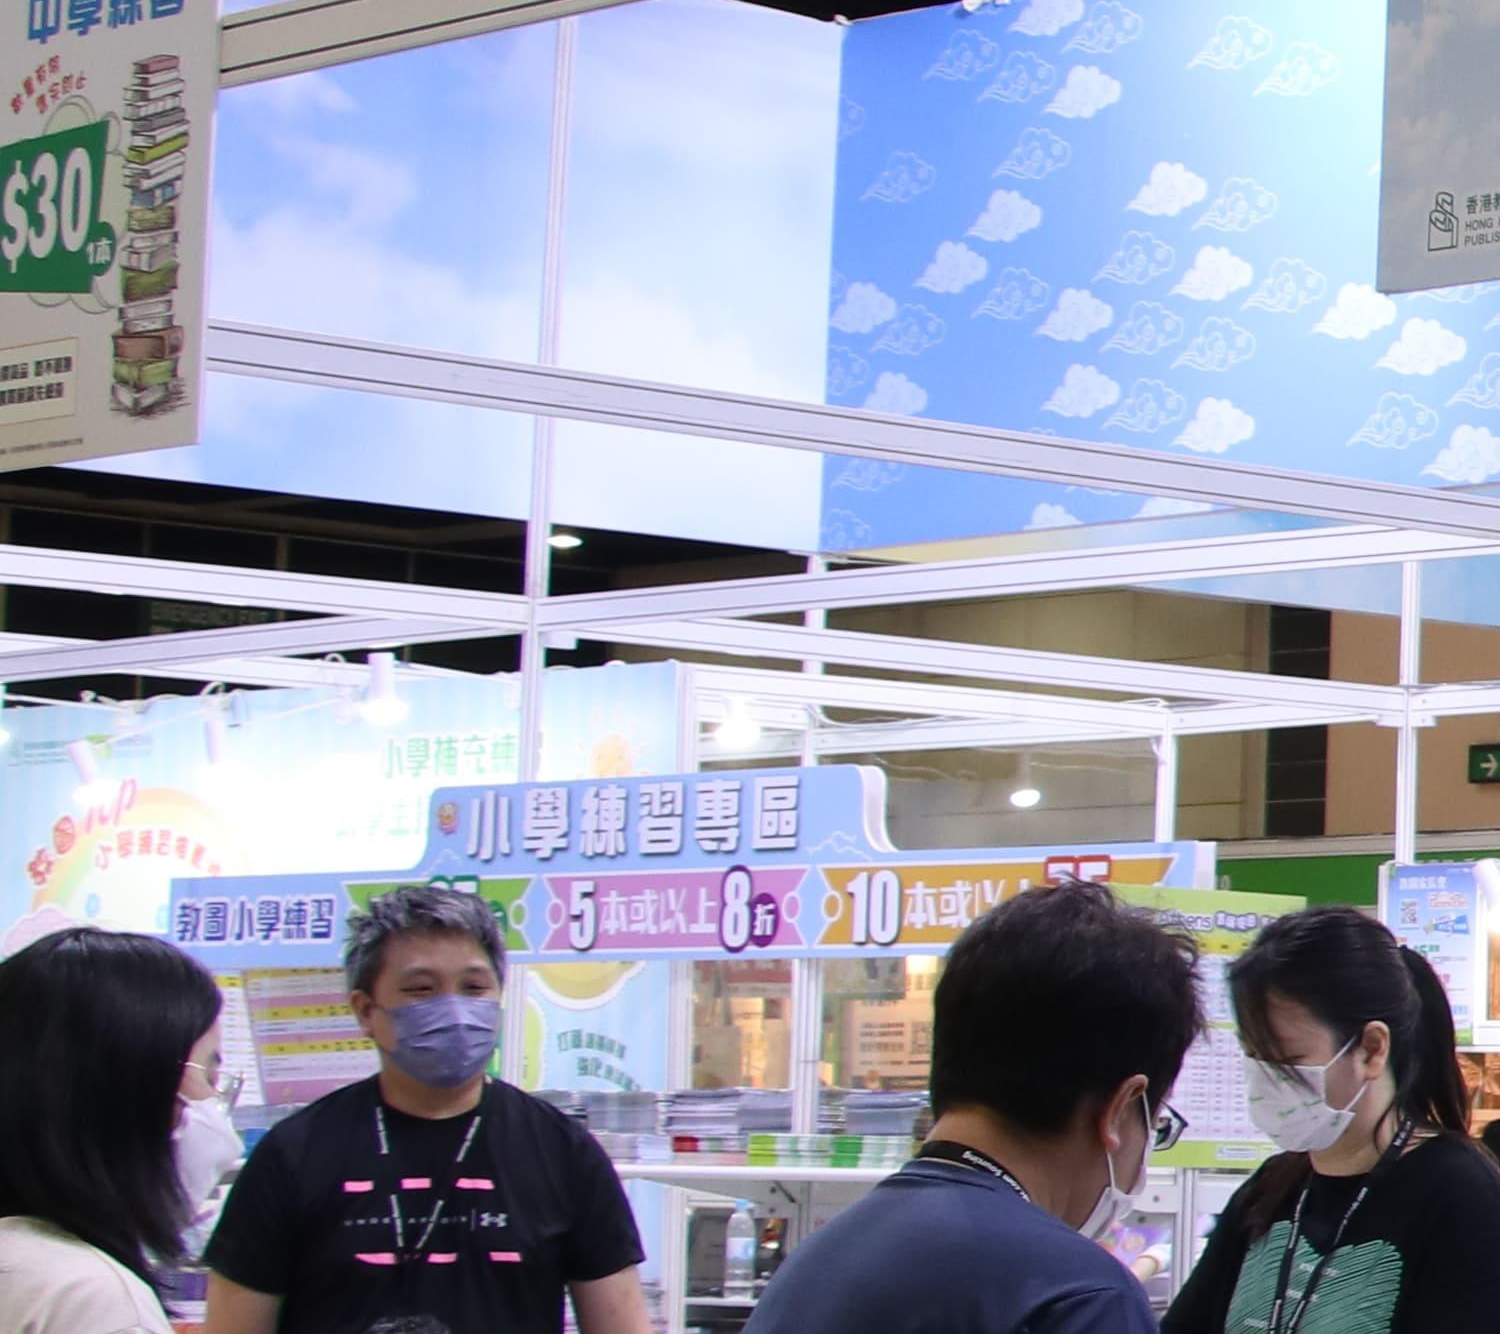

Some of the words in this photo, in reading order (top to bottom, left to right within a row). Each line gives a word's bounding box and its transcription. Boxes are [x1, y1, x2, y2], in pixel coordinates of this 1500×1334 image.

[1, 146, 93, 275] $30
[1465, 214, 1495, 232] HONG
[466, 774, 800, 862] 小學練習專區
[175, 897, 337, 946] 教圖小學練習
